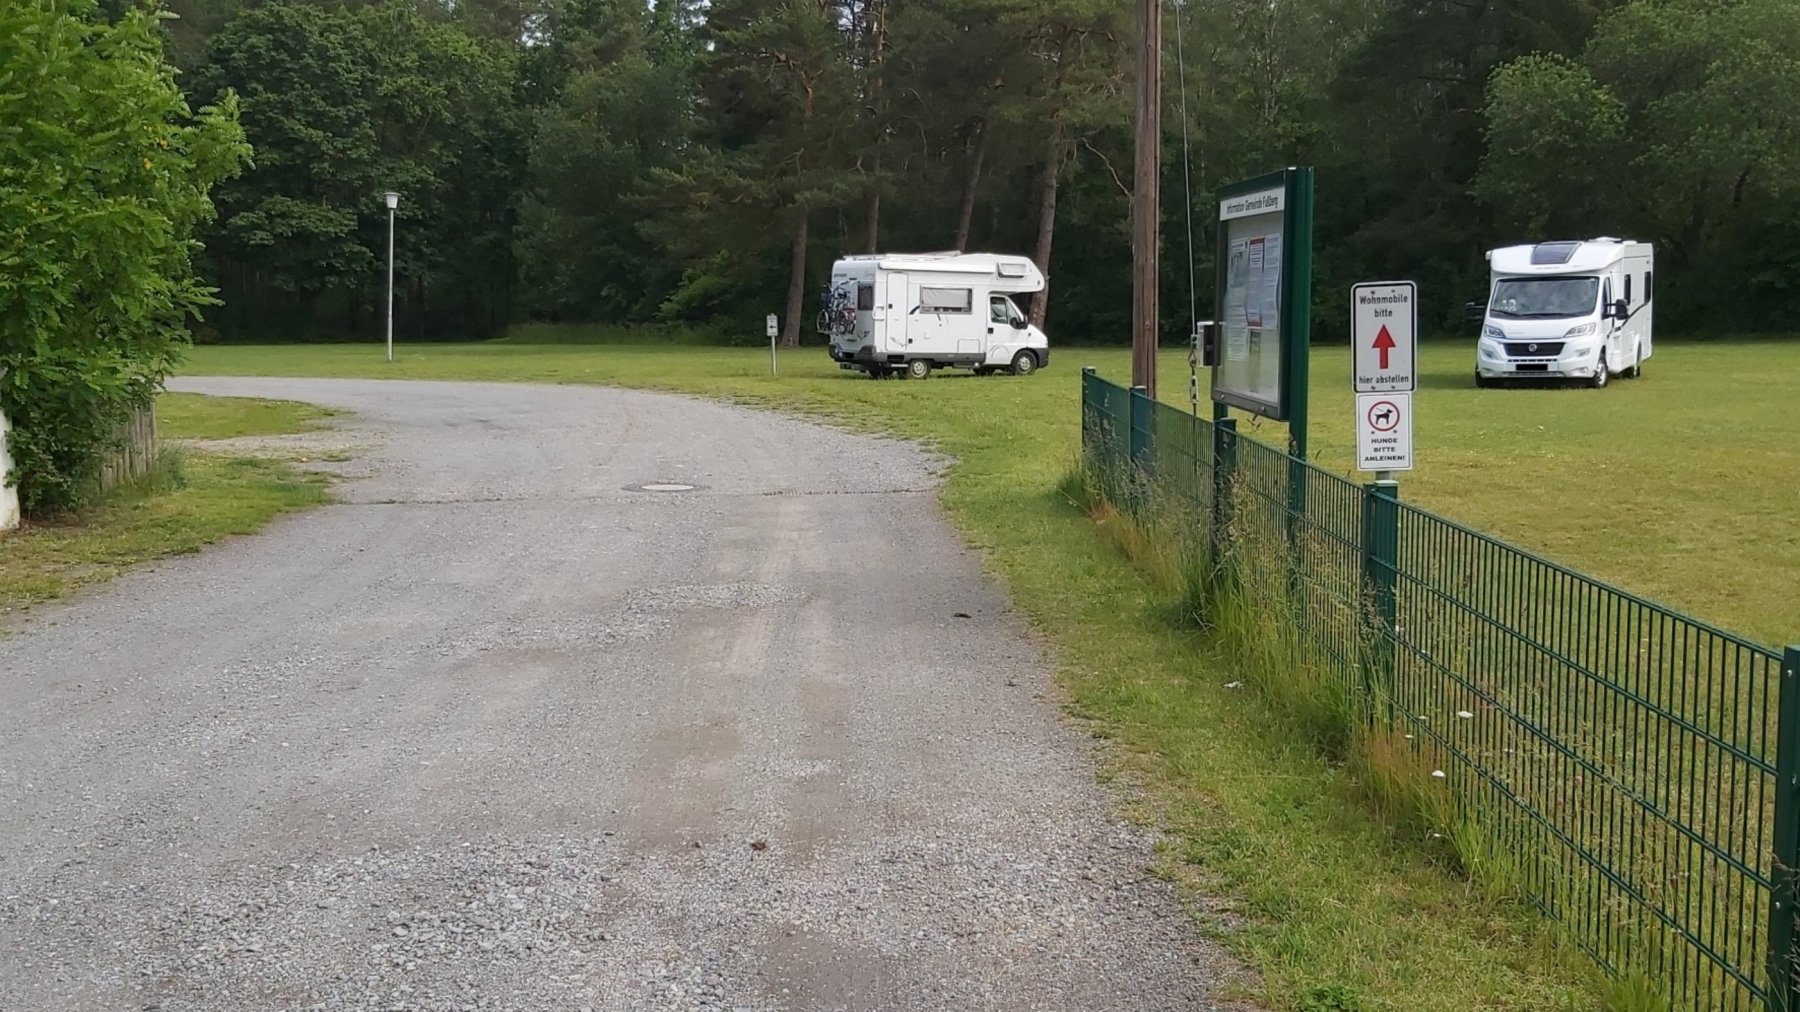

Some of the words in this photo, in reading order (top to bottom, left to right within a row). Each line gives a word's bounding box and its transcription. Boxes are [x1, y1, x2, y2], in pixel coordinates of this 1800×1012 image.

[1359, 293, 1408, 304] Wohnmobile
[1374, 308, 1393, 318] bitte
[1359, 375, 1373, 384] hier
[1375, 374, 1409, 384] abstellen
